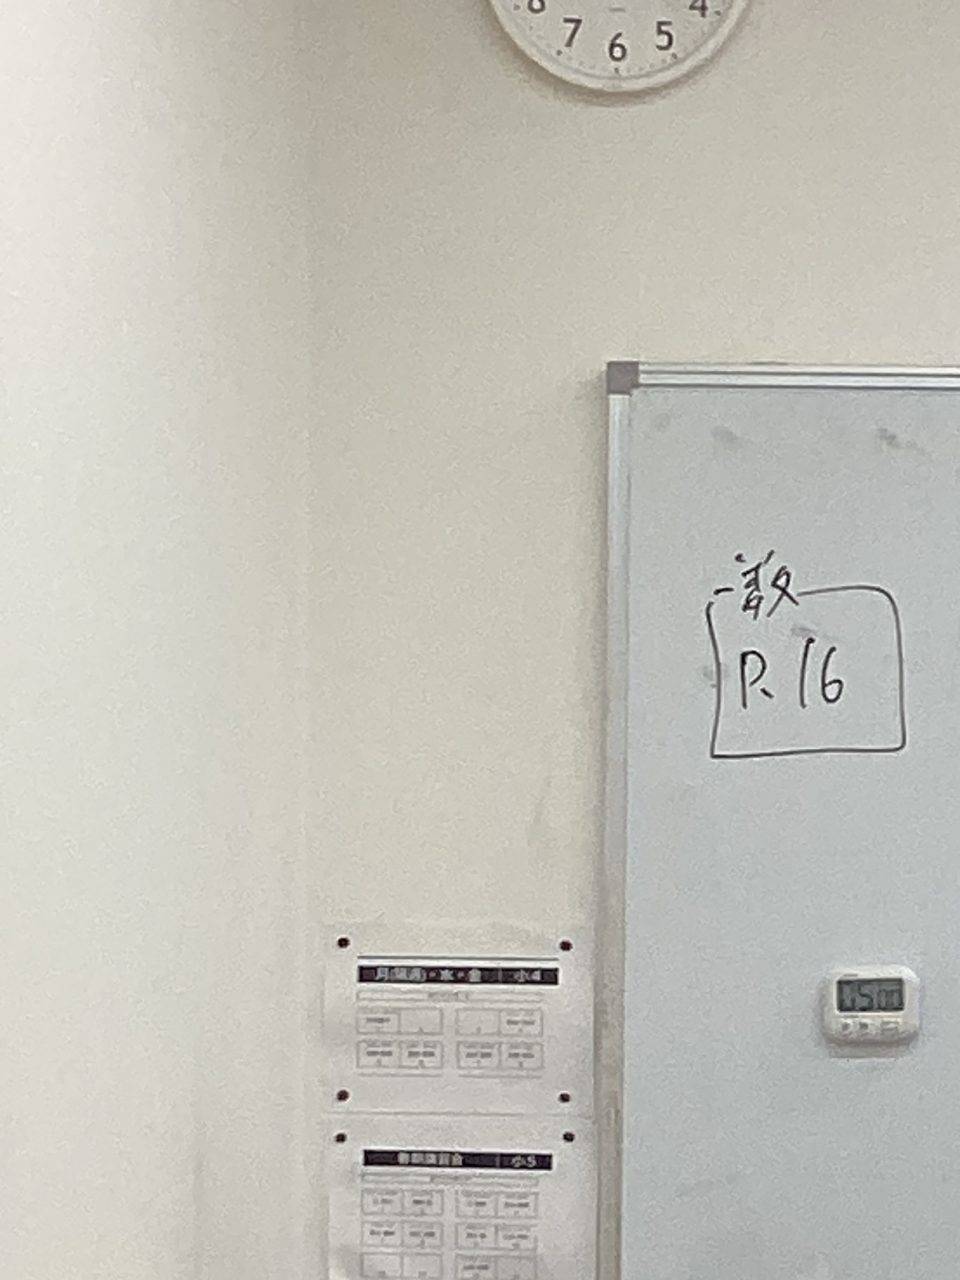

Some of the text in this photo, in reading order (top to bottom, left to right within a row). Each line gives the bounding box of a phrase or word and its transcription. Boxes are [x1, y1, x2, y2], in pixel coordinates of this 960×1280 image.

[562, 17, 583, 48] 7
[608, 32, 627, 62] 6
[655, 20, 674, 50] 5
[800, 636, 844, 709] 16
